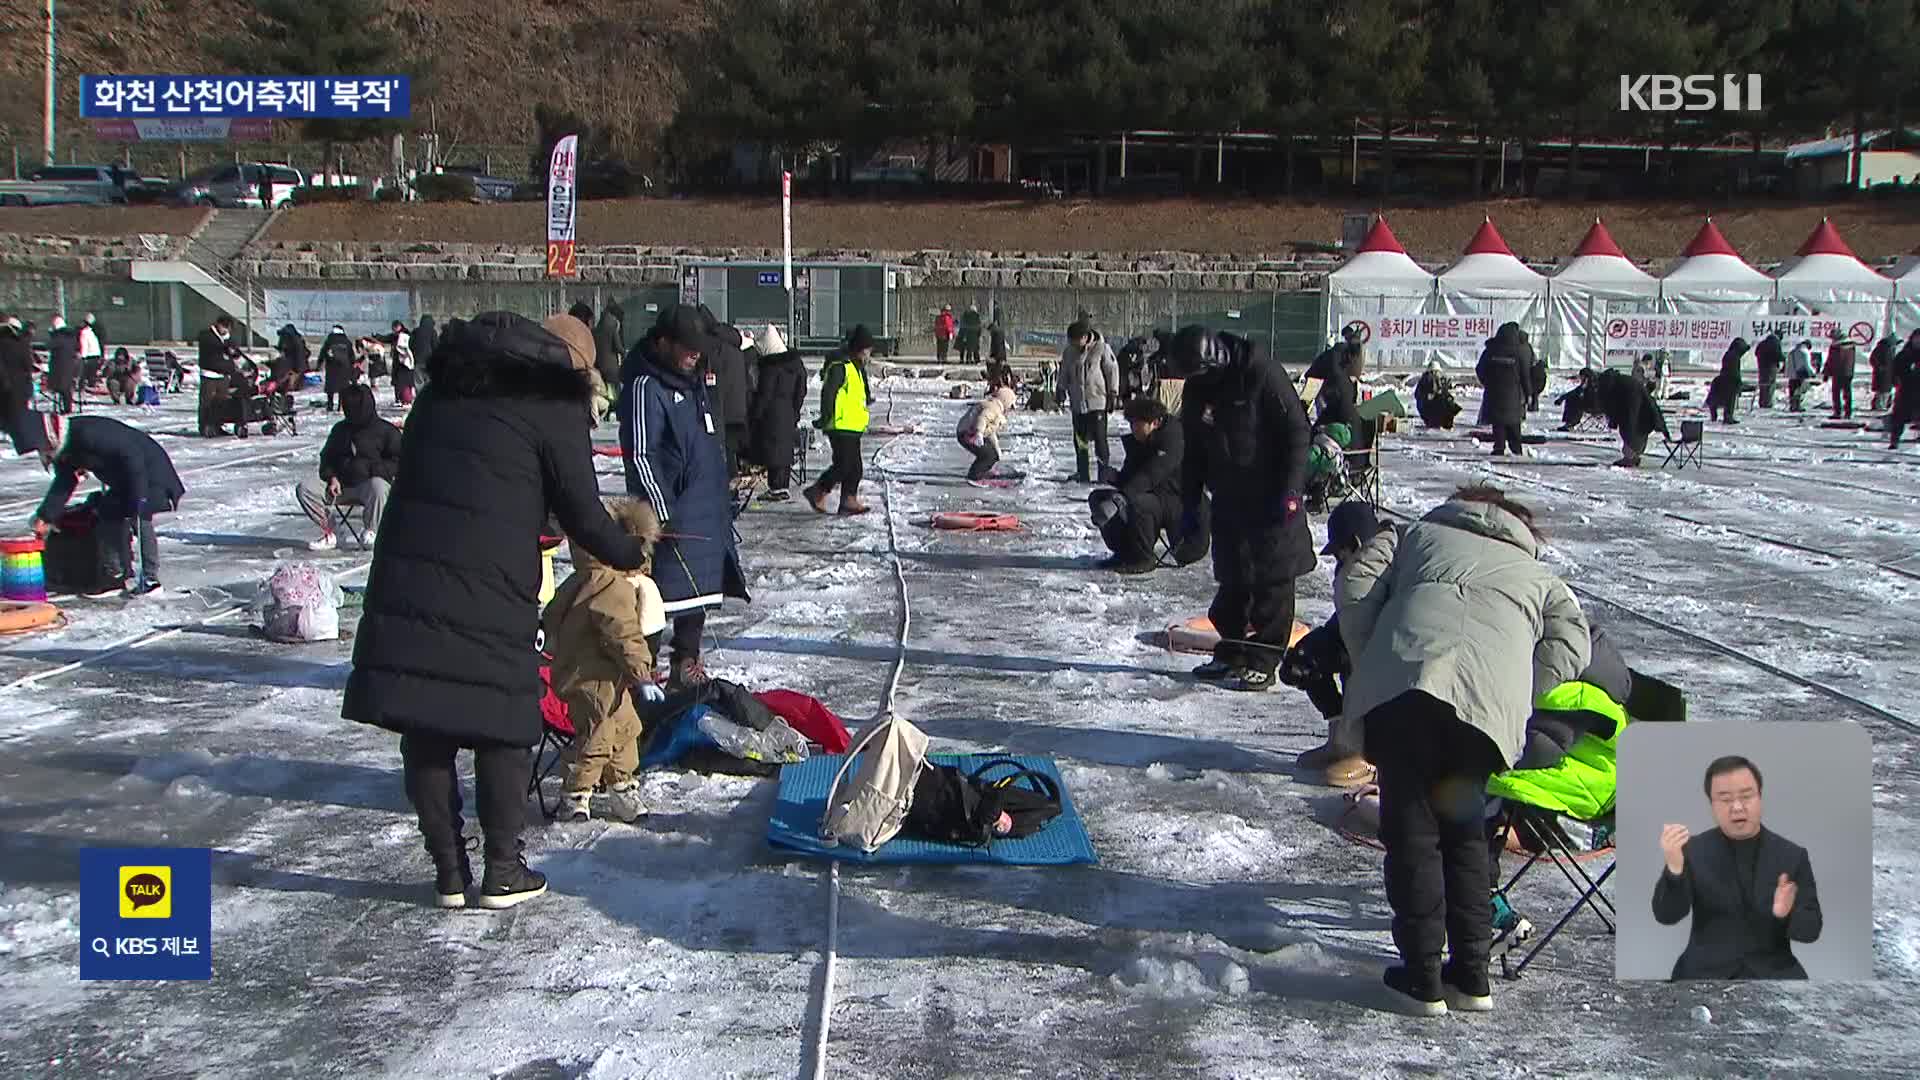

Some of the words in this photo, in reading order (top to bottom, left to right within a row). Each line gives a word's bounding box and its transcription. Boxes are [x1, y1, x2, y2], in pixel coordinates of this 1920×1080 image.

[1422, 318, 1460, 338] 바늘은
[1629, 319, 1666, 338] 음식물과
[1668, 319, 1688, 338] 화기
[1691, 320, 1731, 339] 반입금지!
